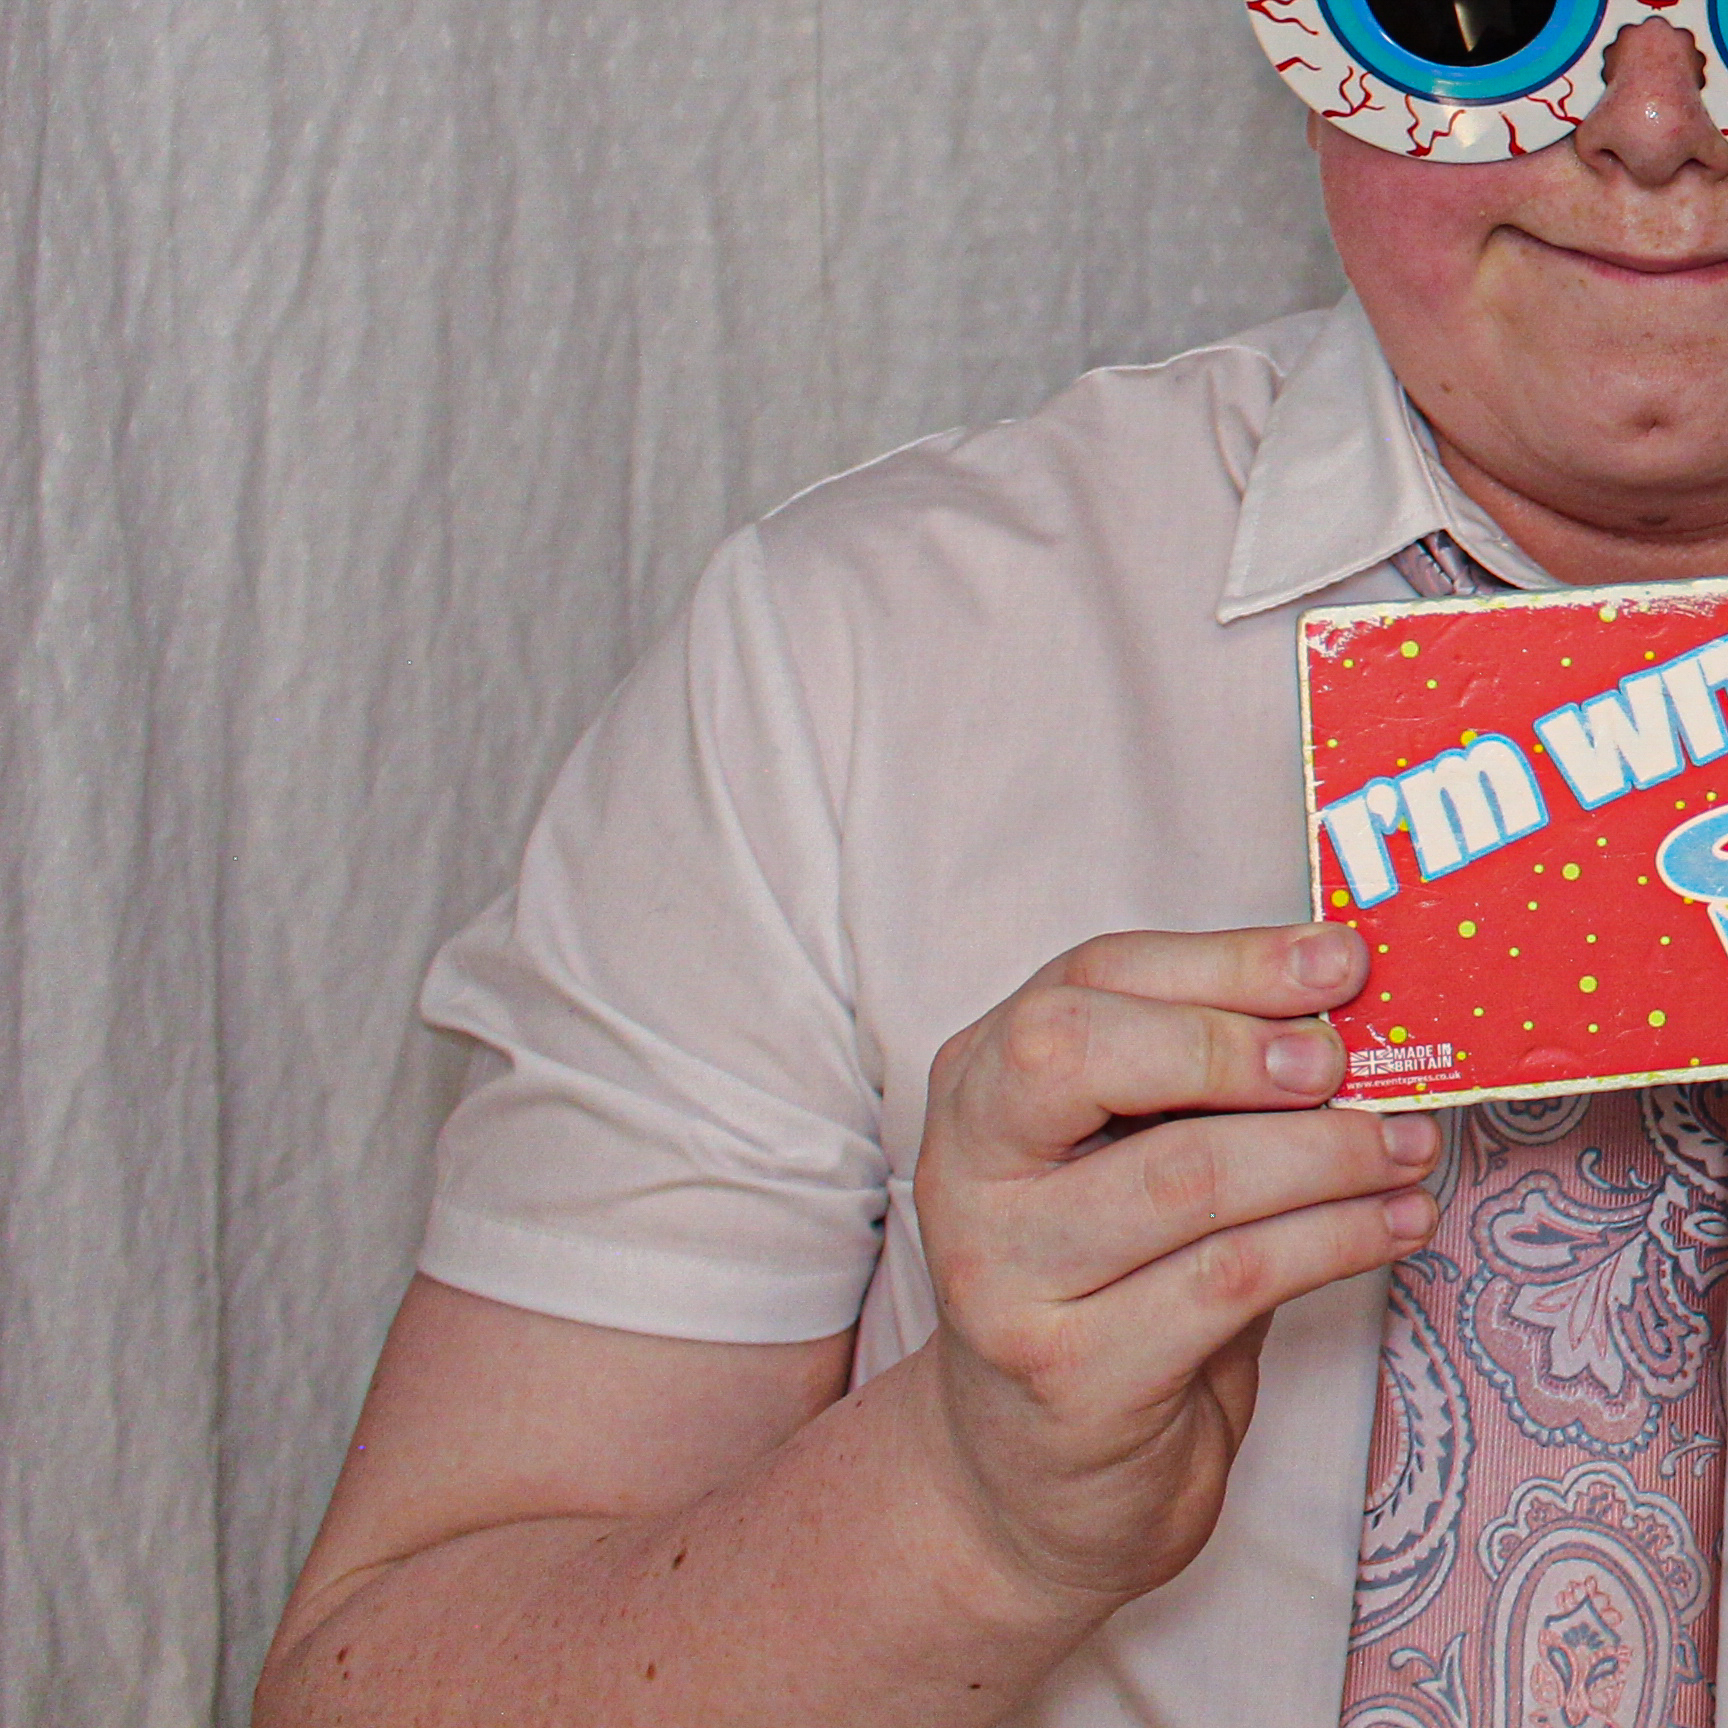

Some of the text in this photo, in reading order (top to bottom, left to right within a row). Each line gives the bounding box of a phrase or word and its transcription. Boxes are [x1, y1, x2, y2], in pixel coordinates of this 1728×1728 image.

[1393, 1043, 1452, 1060] MADE IN
[1394, 1056, 1453, 1072] BRITAIN
